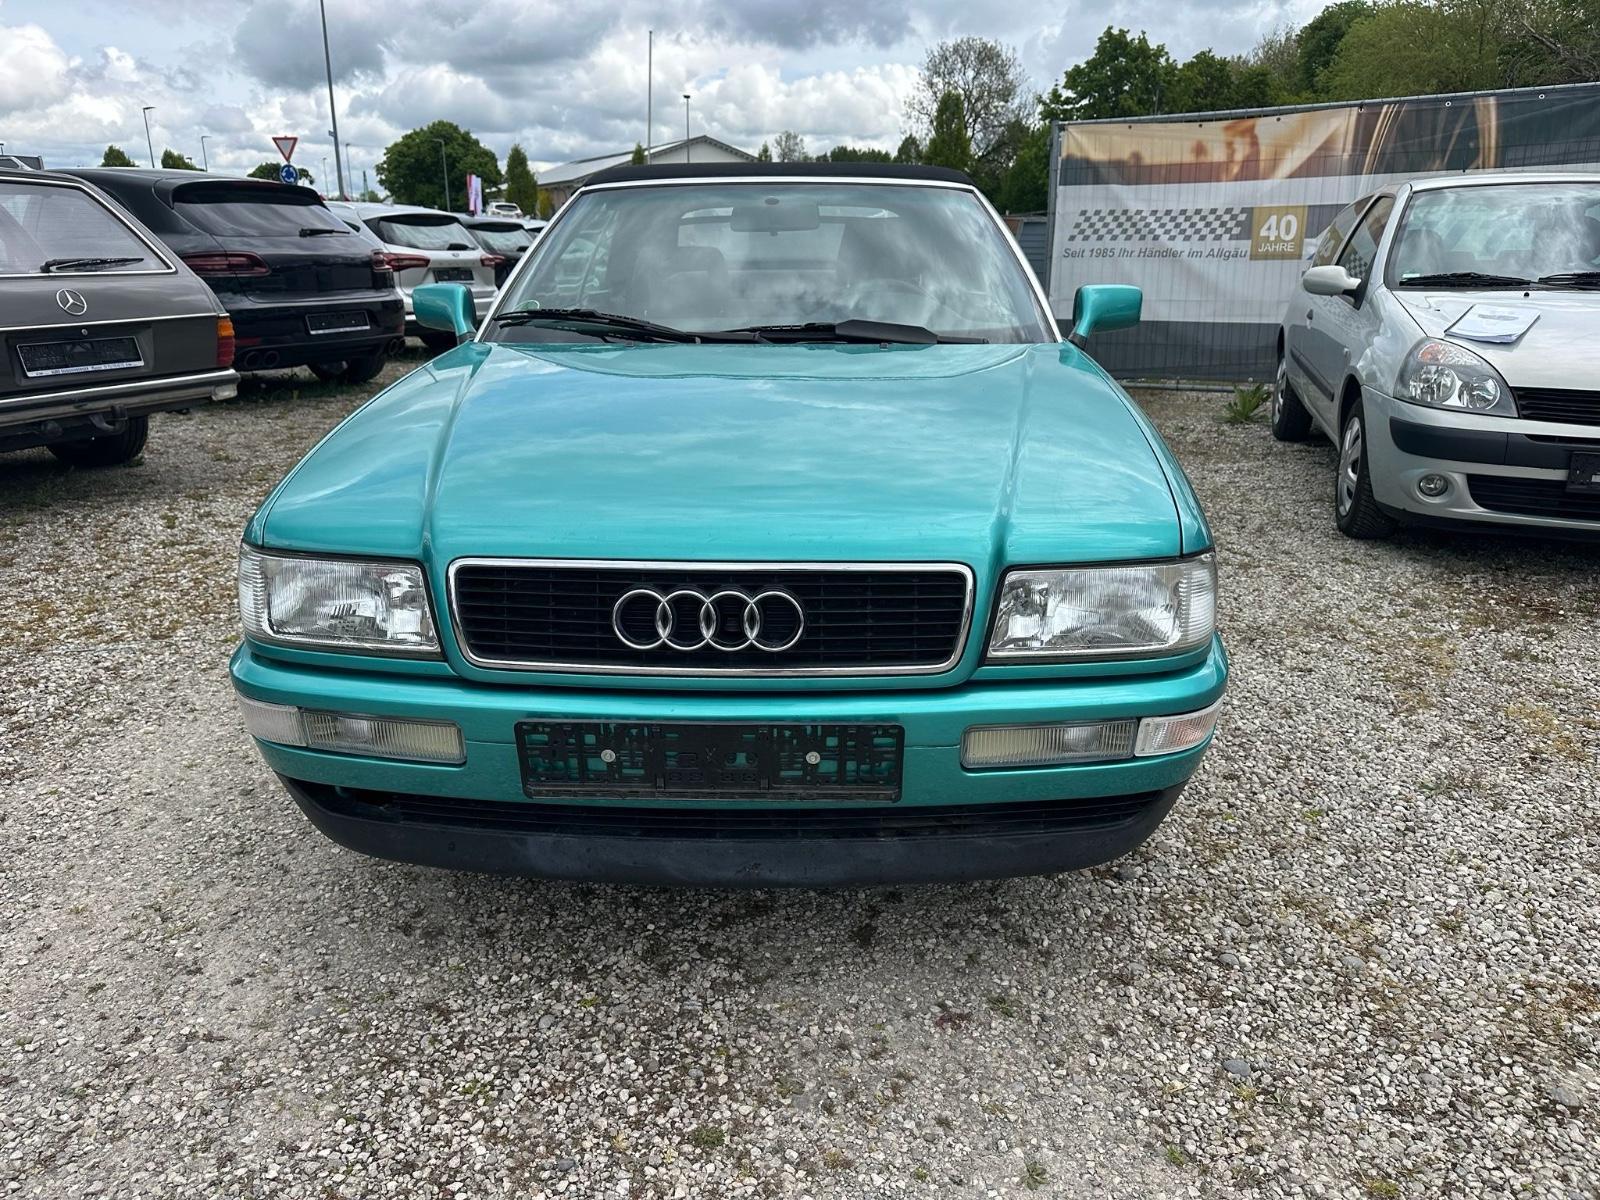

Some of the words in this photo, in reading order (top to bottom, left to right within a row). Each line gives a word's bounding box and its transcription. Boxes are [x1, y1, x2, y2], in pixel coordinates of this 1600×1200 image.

[1260, 214, 1298, 241] 40
[1063, 247, 1086, 258] Seit
[1089, 247, 1116, 258] 1985
[1118, 247, 1135, 258] Ihr
[1137, 247, 1184, 258] Händler
[1187, 247, 1203, 258] im
[1205, 247, 1248, 261] Allgäu
[1258, 242, 1295, 252] JAHRE
